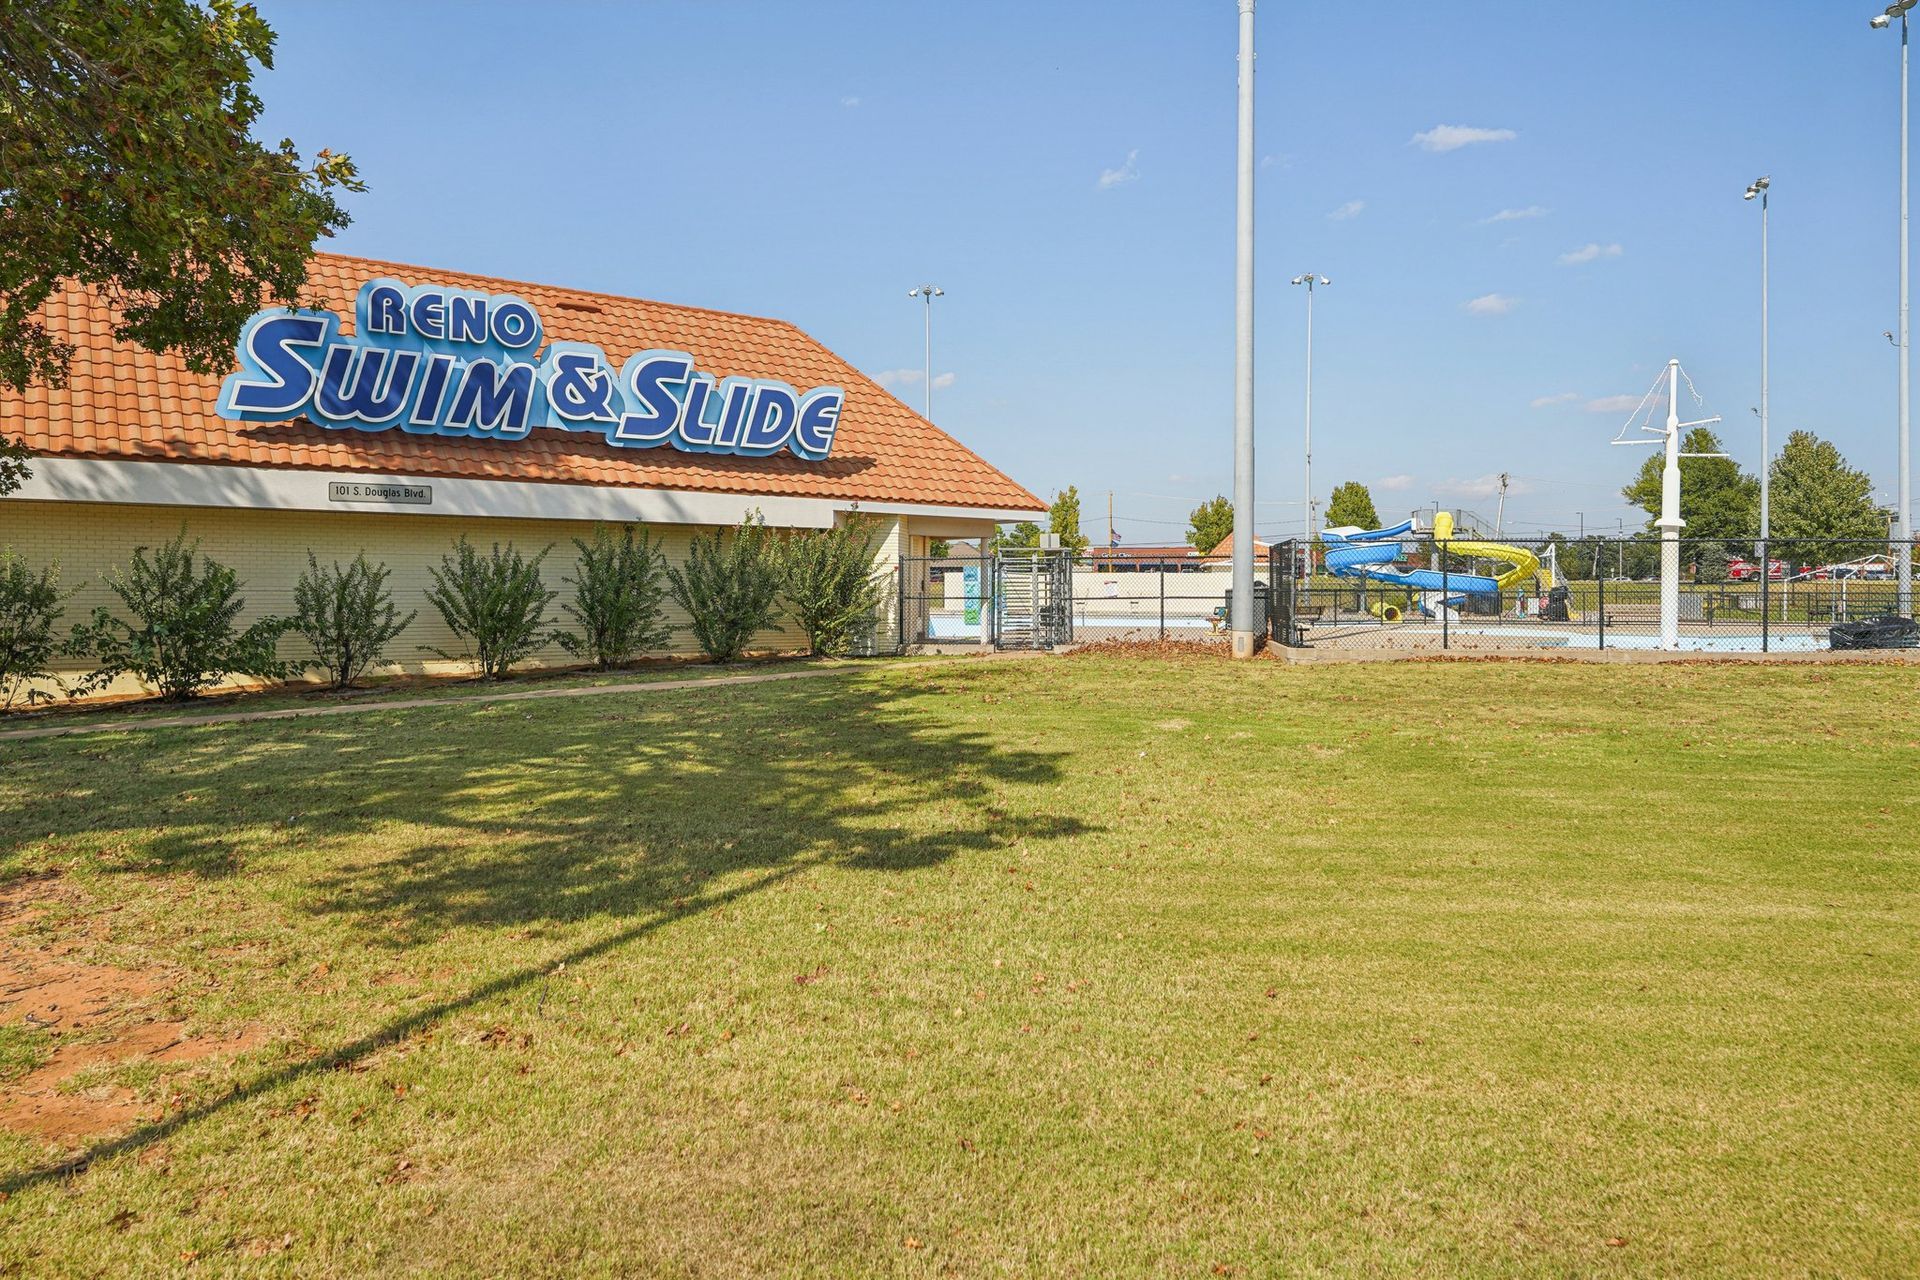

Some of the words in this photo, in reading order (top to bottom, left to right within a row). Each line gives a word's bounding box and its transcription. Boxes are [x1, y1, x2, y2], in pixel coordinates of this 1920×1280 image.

[368, 286, 537, 348] RENO
[227, 314, 537, 432] SWIM
[546, 351, 621, 422] &
[615, 356, 843, 453] SLIDE
[335, 486, 350, 496] 101
[353, 486, 362, 496] S.
[365, 487, 401, 499] Douglas
[404, 488, 426, 498] Blvd.
